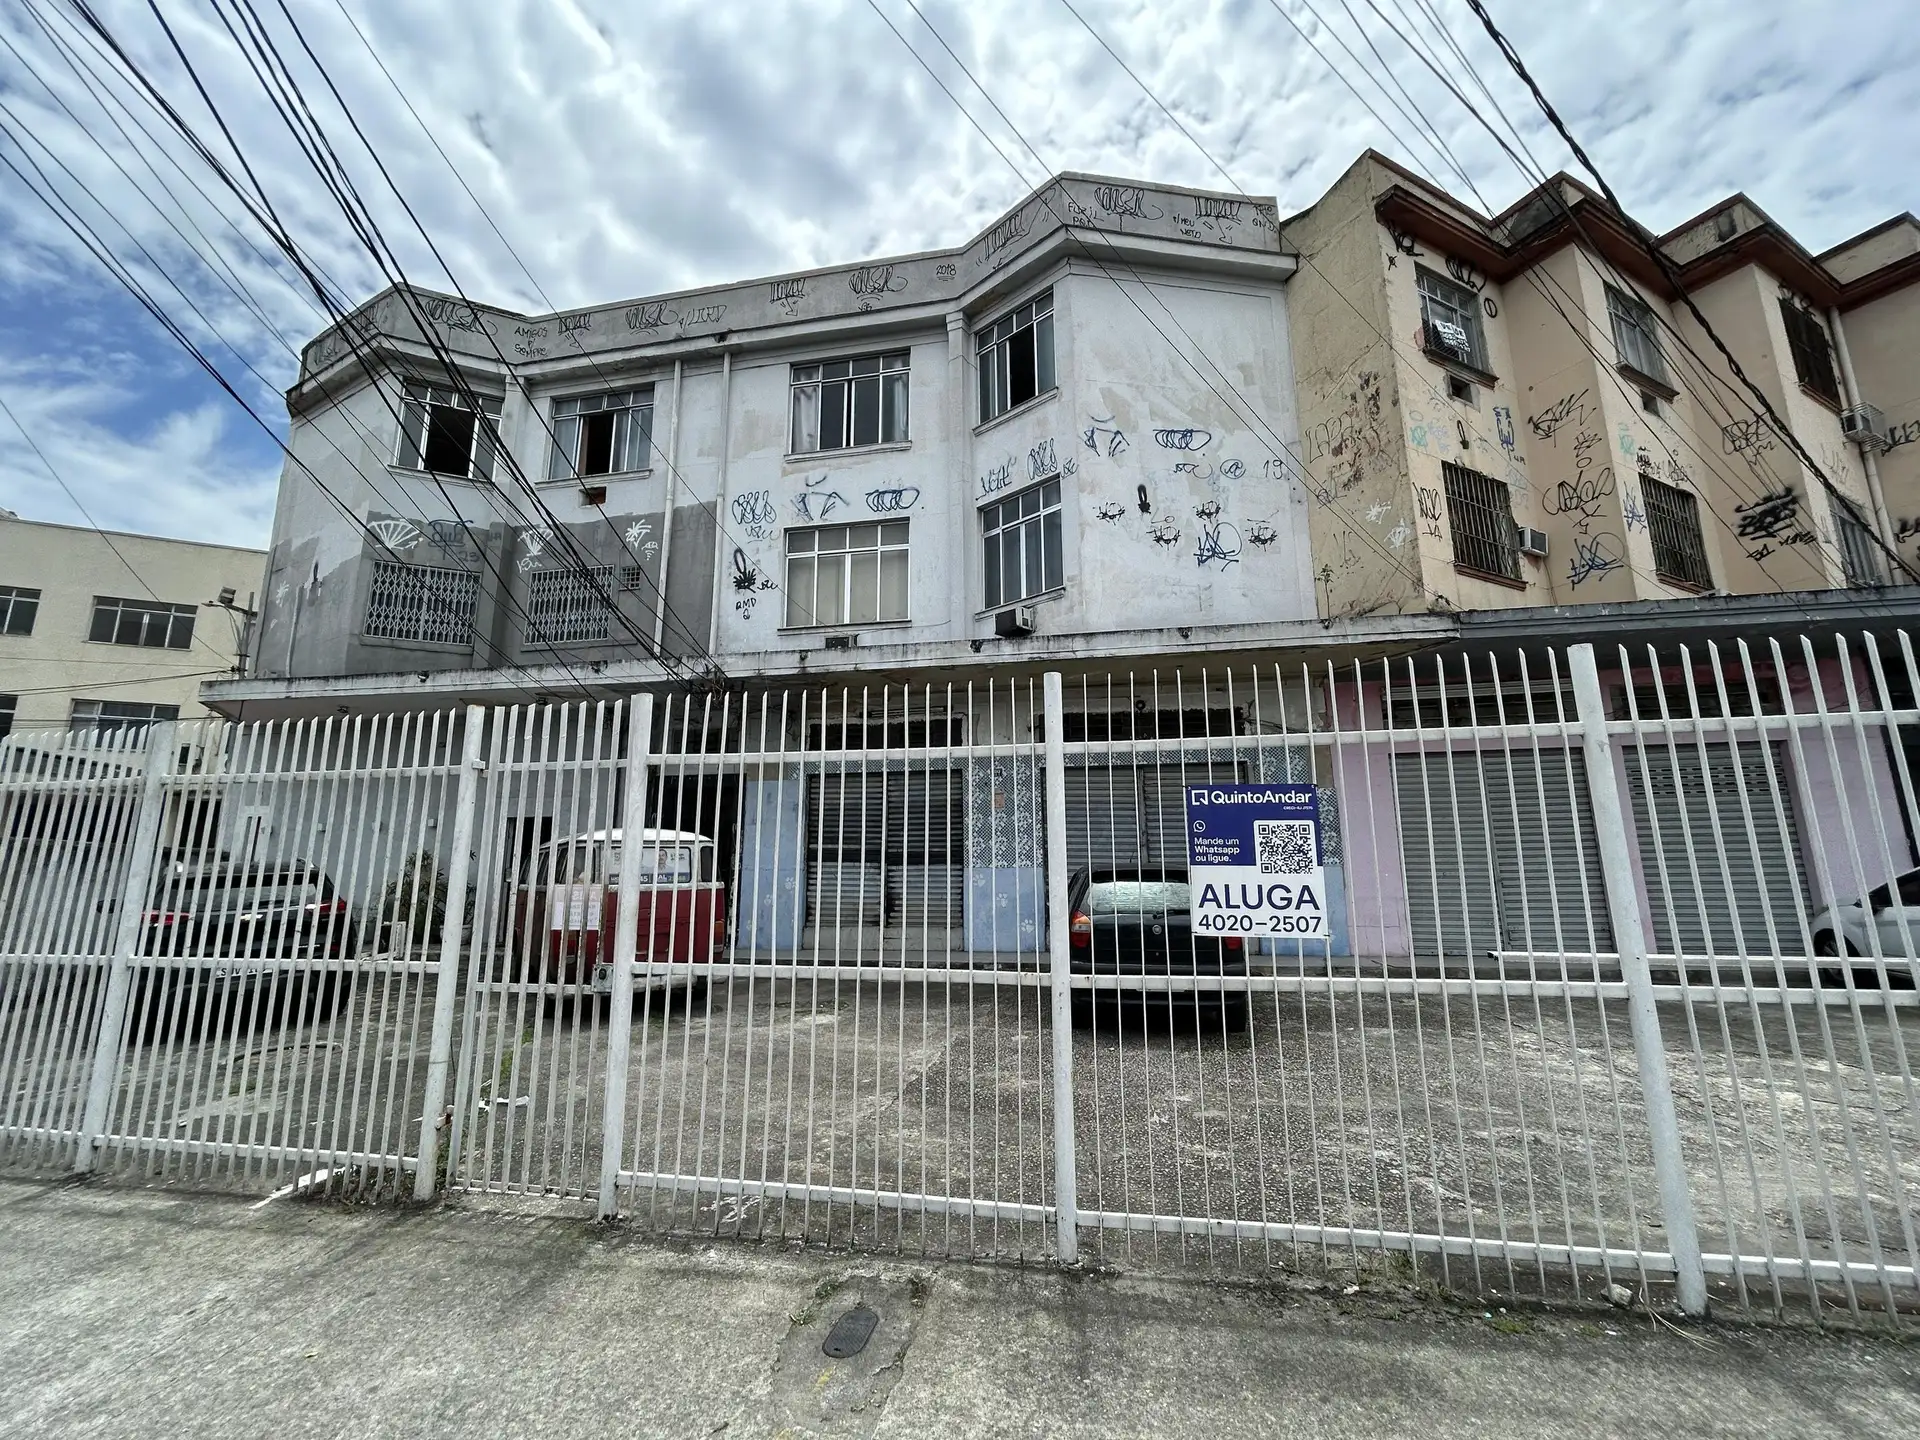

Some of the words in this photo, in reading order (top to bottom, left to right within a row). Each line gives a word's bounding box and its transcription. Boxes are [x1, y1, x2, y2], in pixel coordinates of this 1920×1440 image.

[936, 263, 957, 277] 2018
[1211, 790, 1313, 804] QuintoAndar
[1194, 837, 1224, 845] Mande
[1195, 846, 1240, 855] Whatsapp
[1207, 853, 1232, 864] ligue.
[1198, 884, 1320, 910] ALUGA
[1198, 914, 1322, 933] 4020-2507
